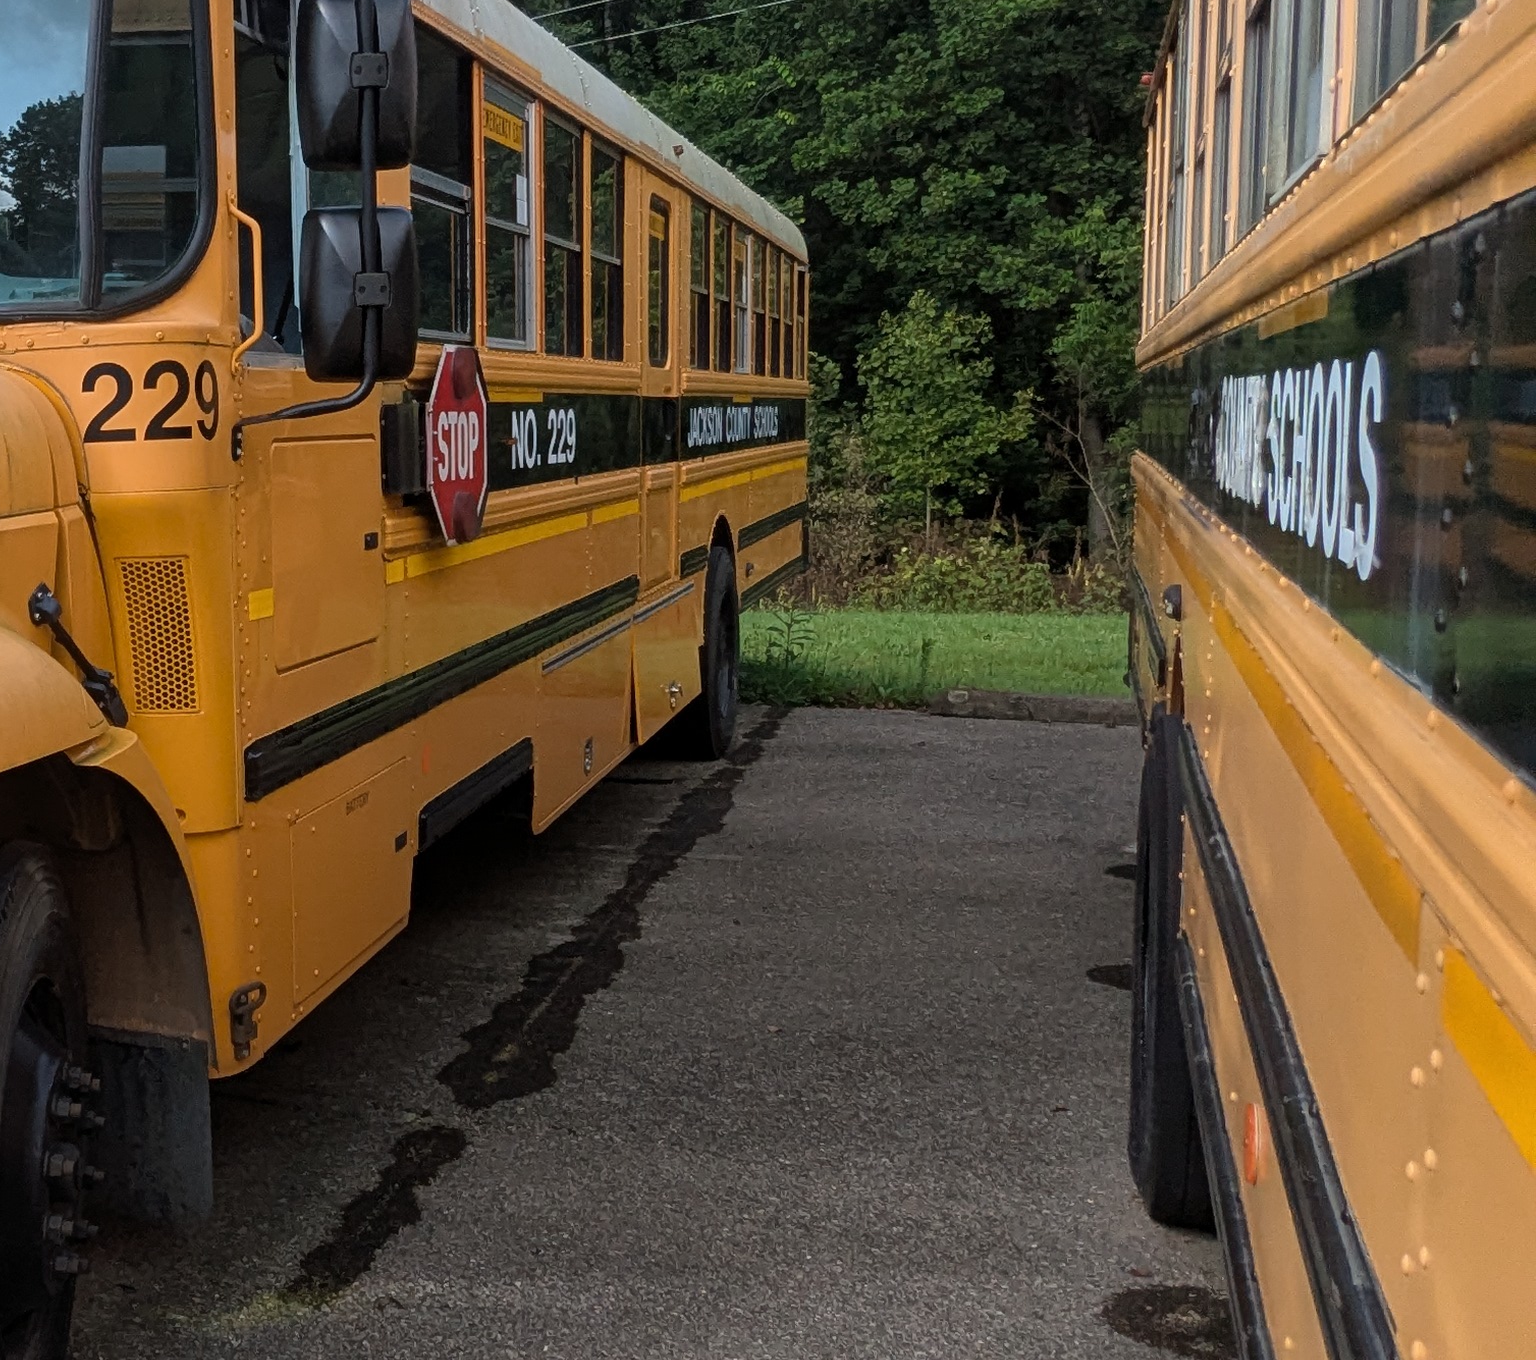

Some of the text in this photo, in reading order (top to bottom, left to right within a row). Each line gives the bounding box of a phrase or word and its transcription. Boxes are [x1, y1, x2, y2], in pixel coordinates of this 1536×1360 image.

[81, 359, 220, 443] 229
[687, 405, 779, 448] JACKSON COUNTY SCHOOLS
[437, 410, 479, 482] STOP
[511, 408, 577, 470] NO. 229
[1266, 350, 1382, 582] SCHOOLS
